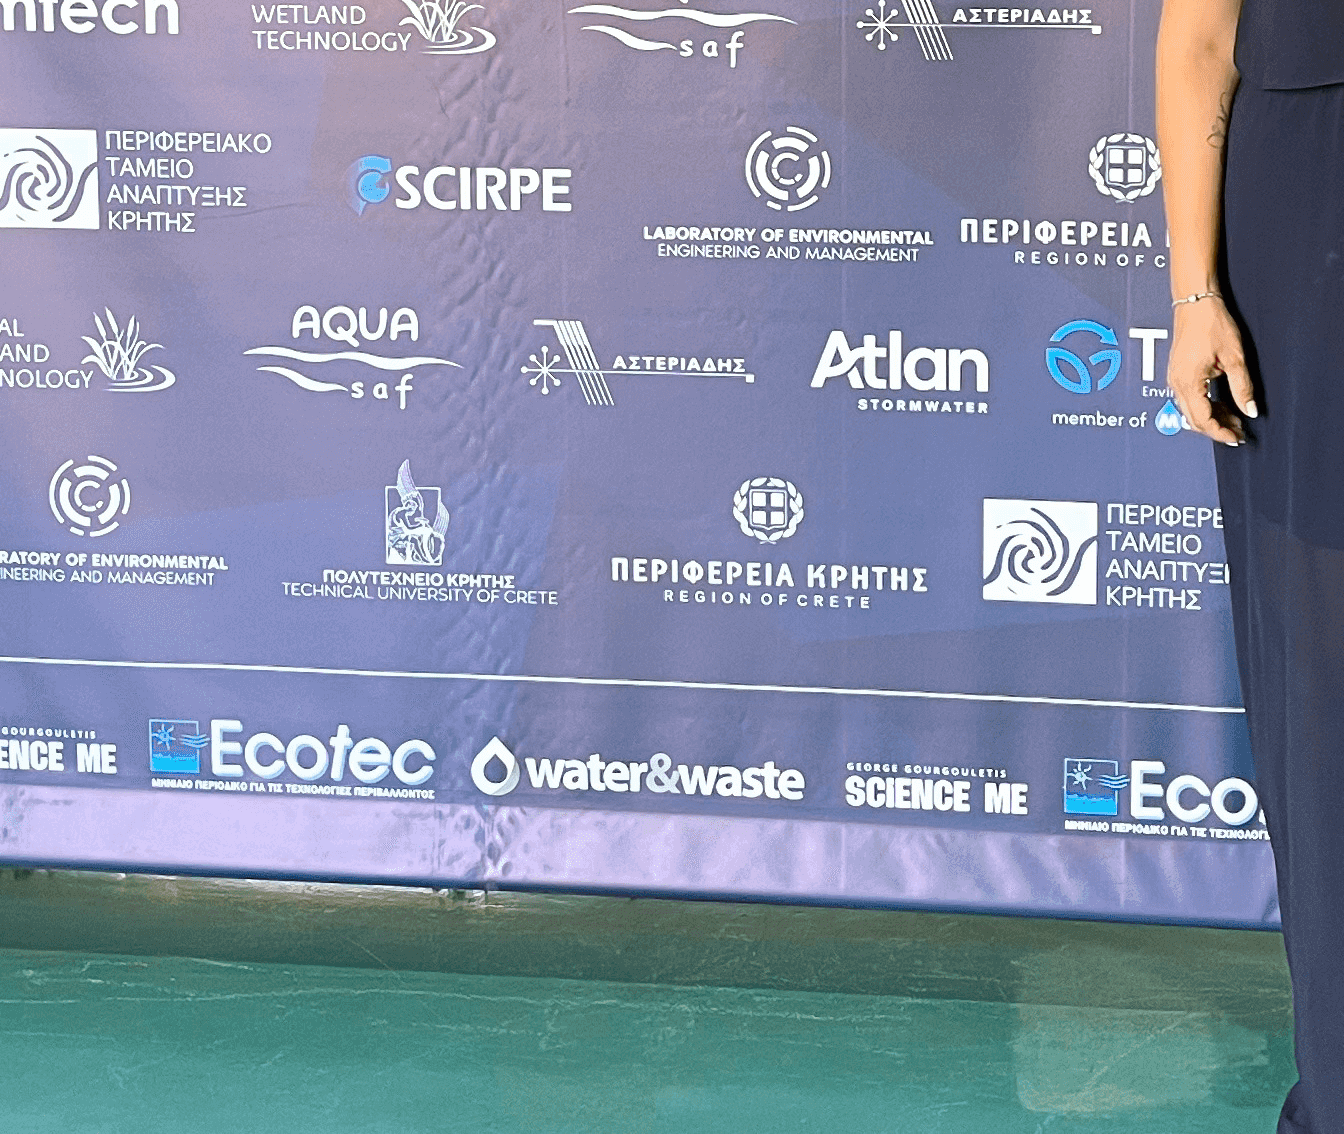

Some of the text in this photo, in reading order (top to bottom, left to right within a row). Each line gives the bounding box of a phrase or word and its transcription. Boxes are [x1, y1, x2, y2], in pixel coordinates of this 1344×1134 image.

[251, 5, 366, 24] WETLAND
[953, 9, 1091, 23] ΑΣΤΕΡΙΑΔΗΣ
[252, 31, 411, 51] TECHNOLOGY
[680, 31, 744, 68] saf
[106, 131, 271, 153] ΠΕΡΙΦΕΡΕΙΑΚΟ
[105, 157, 193, 178] ΤΑΜΕΙΟ
[107, 184, 247, 206] ΑΝΑΠΤΥΞΗΣ
[396, 166, 571, 211] SCIRPE
[109, 211, 195, 232] ΚΡΗΤΗΣ
[644, 226, 933, 244] LABORATORY OF ENVIRONMENTAL
[961, 219, 1151, 247] ΠΕΡΙΦΕΡΕΙΑ
[658, 243, 919, 261] ENGINEERING AND MANAGEMENT
[1015, 251, 1106, 265] REGION
[1117, 254, 1144, 266] OF
[293, 306, 418, 347] AQUA
[613, 356, 745, 372] ΑΣΤΕΡΙΑΔΗΣ
[811, 331, 988, 392] Atlan
[351, 374, 413, 409] saf
[858, 399, 987, 413] STORMWATER
[1053, 411, 1124, 426] member
[1129, 412, 1147, 427] of
[1106, 531, 1201, 555] ΤΑΜΕΙΟ
[66, 553, 87, 566] OF
[92, 554, 228, 570] ENVIRONMENTAL
[1106, 559, 1229, 584] ΑΝΑΠΤΥΞ
[70, 570, 102, 583] AND
[108, 571, 214, 585] MANAGEMENT
[323, 570, 515, 588] ΠΟΛΥΤΕΧΝΕΙΟ ΚΡΗΤΗΣ
[612, 558, 927, 591] ΠΕΡΙΦΕΡΕΙΑ ΚΡΗΤΗΣ
[282, 582, 558, 605] TECHNICAL UNIVERSITY OF CRETE
[664, 590, 871, 610] REGION OF CRETE
[1107, 586, 1201, 610] ΚΡΗΤΗΣ
[77, 743, 117, 773] ME
[210, 719, 437, 786] Ecotec
[525, 753, 804, 802] water&waste
[847, 763, 1006, 778] GEORGE GOURGOULETIS
[250, 782, 266, 792] ΓΙΑ
[845, 775, 1028, 814] SCIENCE ME
[1130, 760, 1266, 826] Eco
[1171, 826, 1188, 836] ΓΙΑ
